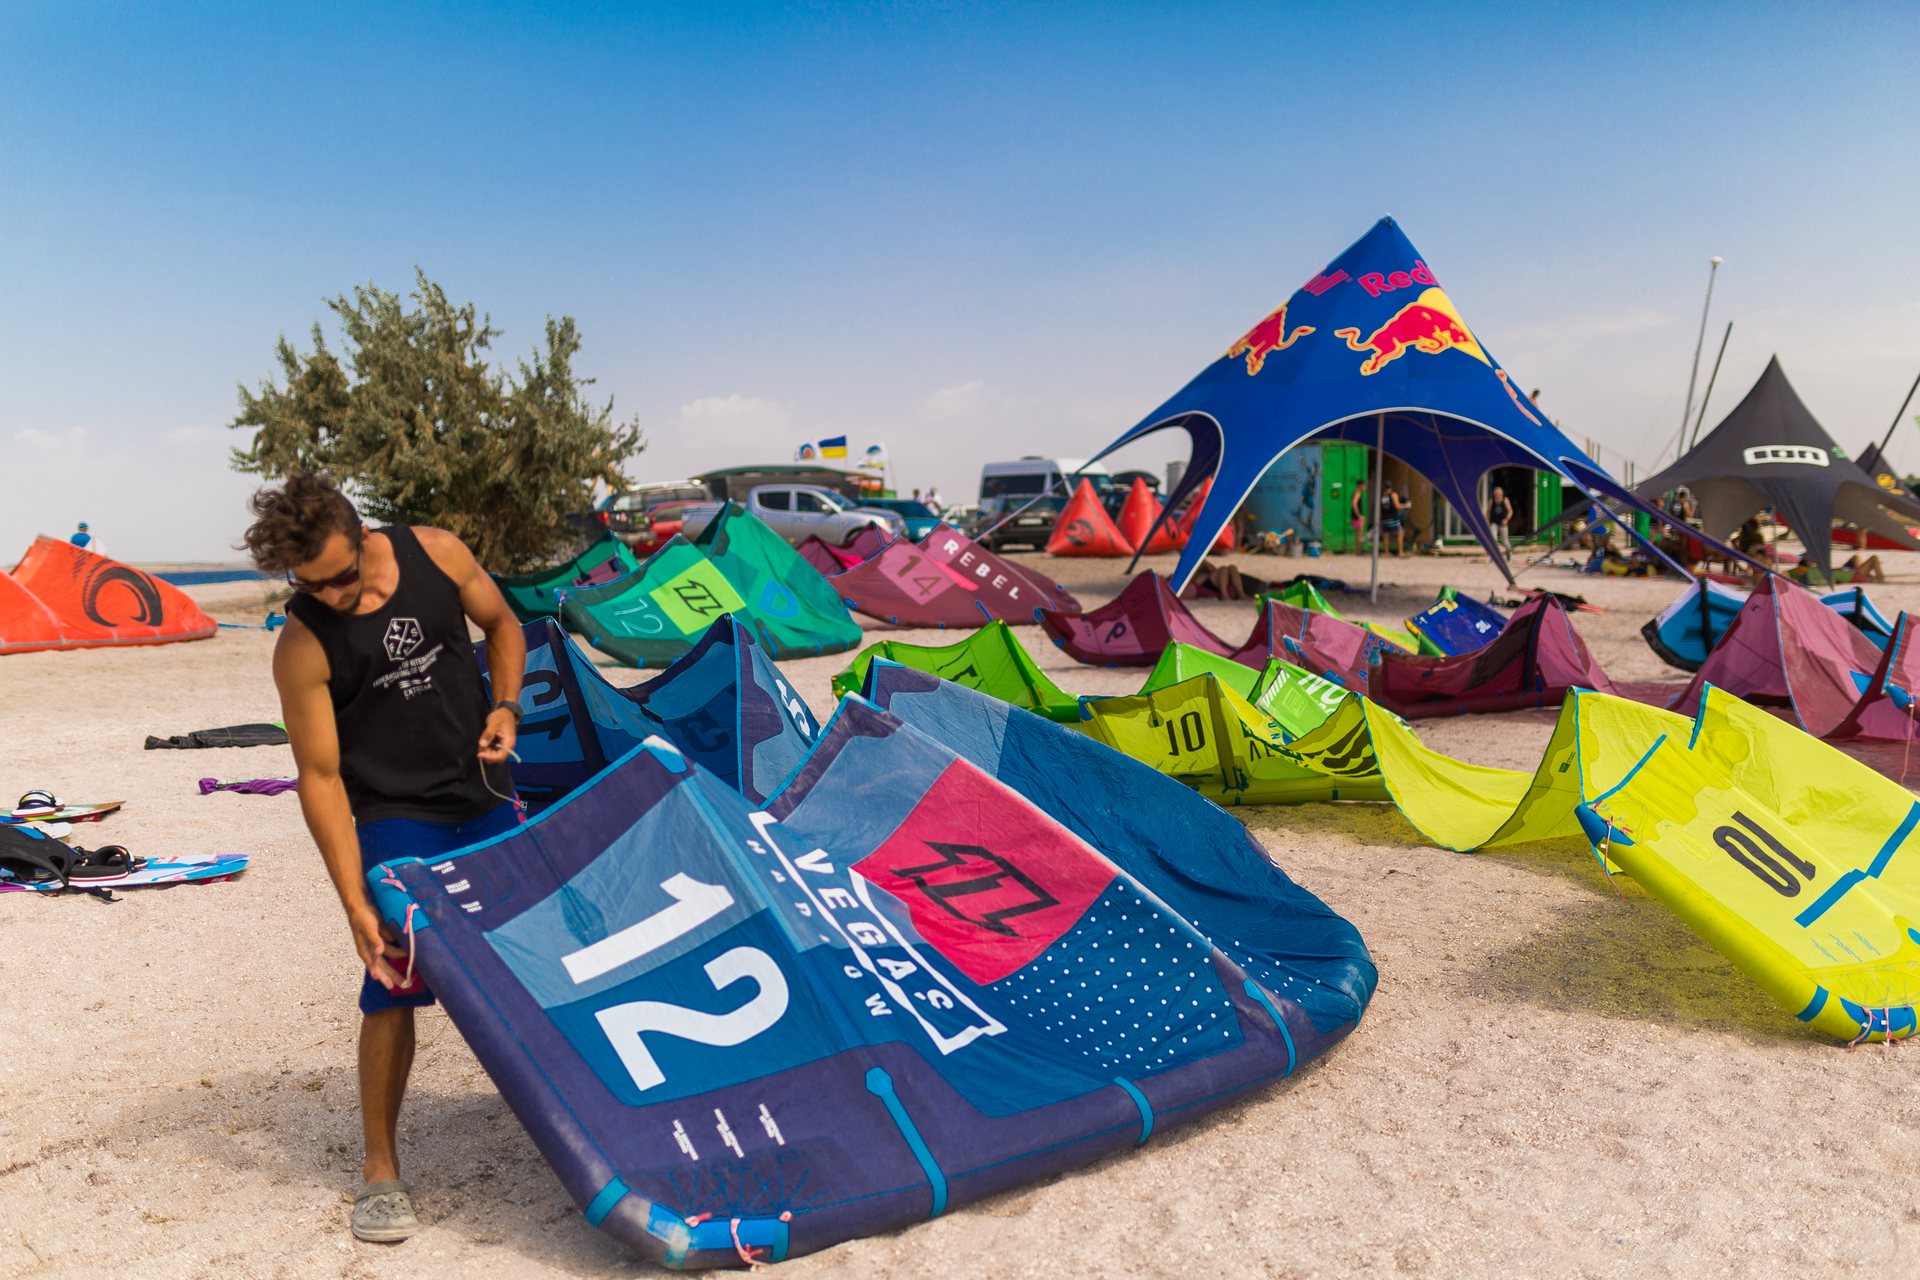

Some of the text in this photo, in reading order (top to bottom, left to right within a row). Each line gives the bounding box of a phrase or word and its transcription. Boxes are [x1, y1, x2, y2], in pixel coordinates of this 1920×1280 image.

[1358, 260, 1437, 298] Red
[897, 554, 942, 596] 14
[943, 539, 1020, 600] REBEL
[1712, 811, 1816, 897] 10
[561, 872, 790, 1093] 12
